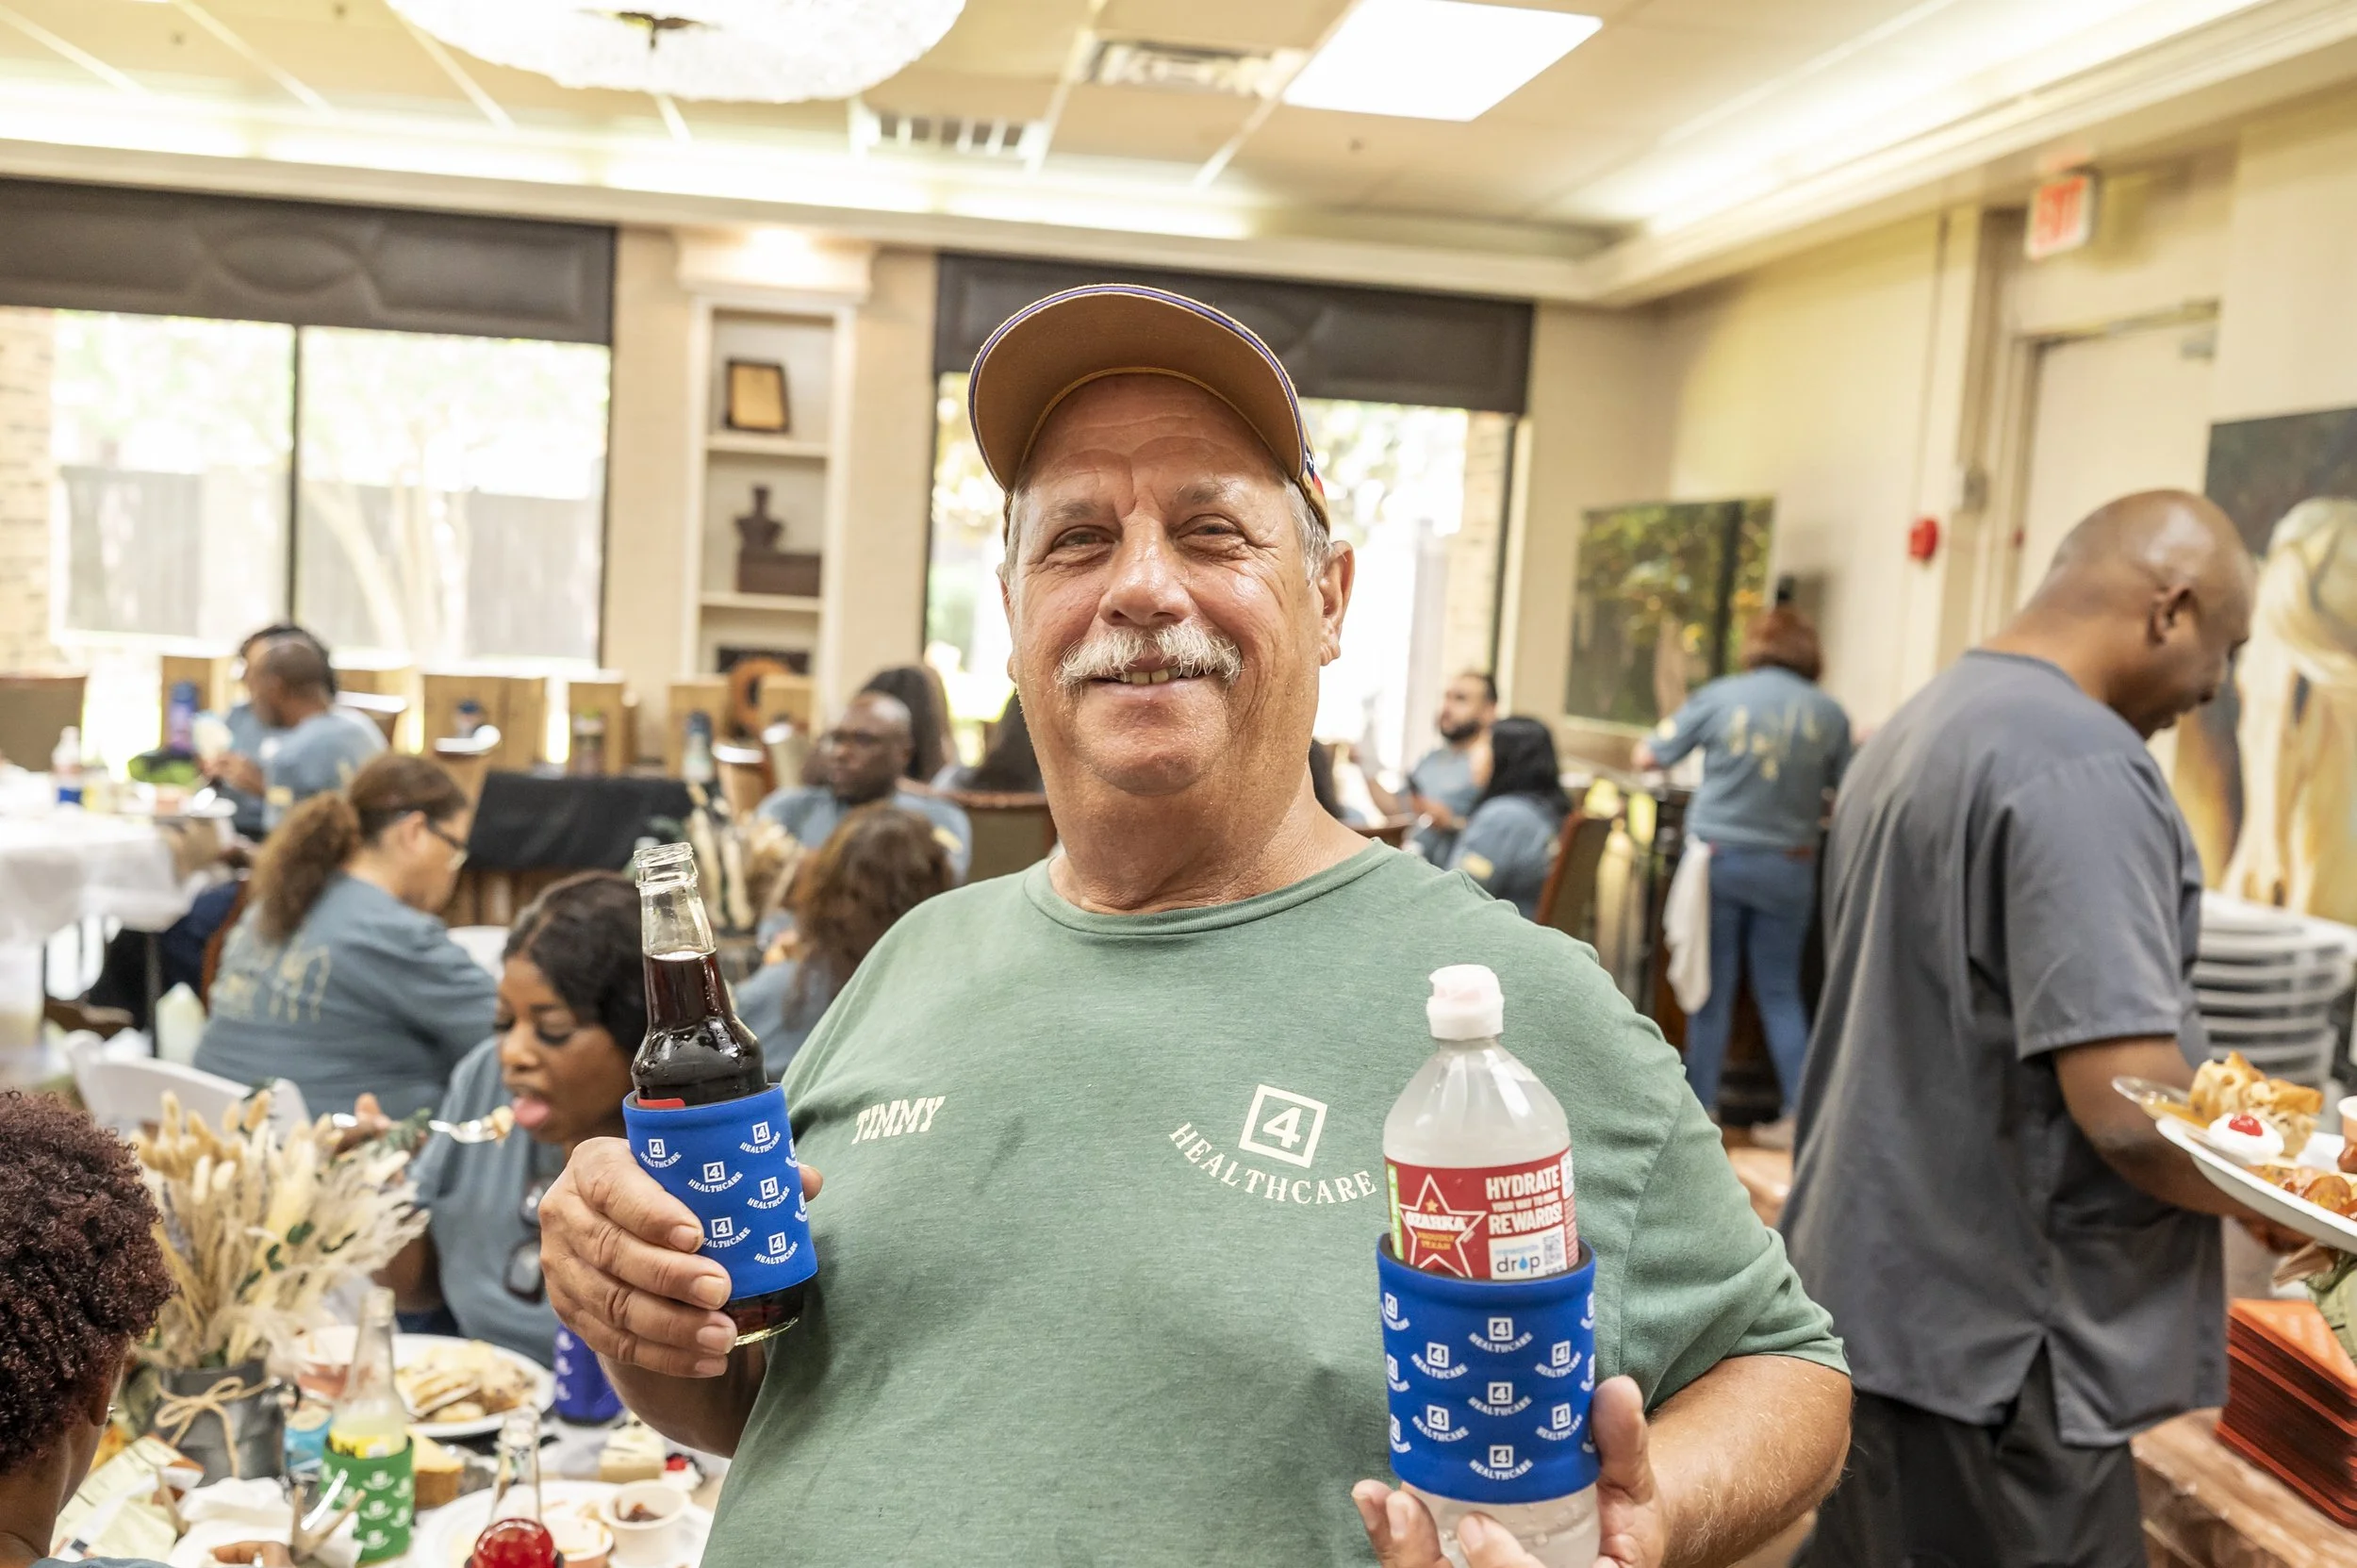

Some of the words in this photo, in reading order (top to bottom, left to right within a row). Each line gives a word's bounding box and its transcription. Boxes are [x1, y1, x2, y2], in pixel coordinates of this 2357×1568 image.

[851, 1096, 946, 1145] TIMMY
[1262, 1106, 1302, 1148] 4
[739, 1131, 782, 1154] HEALTHCARE
[639, 1151, 683, 1168] HEALTHCARE
[1169, 1122, 1376, 1204] HEALTHCARE
[687, 1171, 743, 1193] HEALTHCARE
[1485, 1164, 1561, 1200] HYDRATE
[747, 1186, 791, 1210] HEALTHCARE
[703, 1227, 751, 1249] EALTHCARE
[754, 1241, 799, 1265] HEALTHCARE
